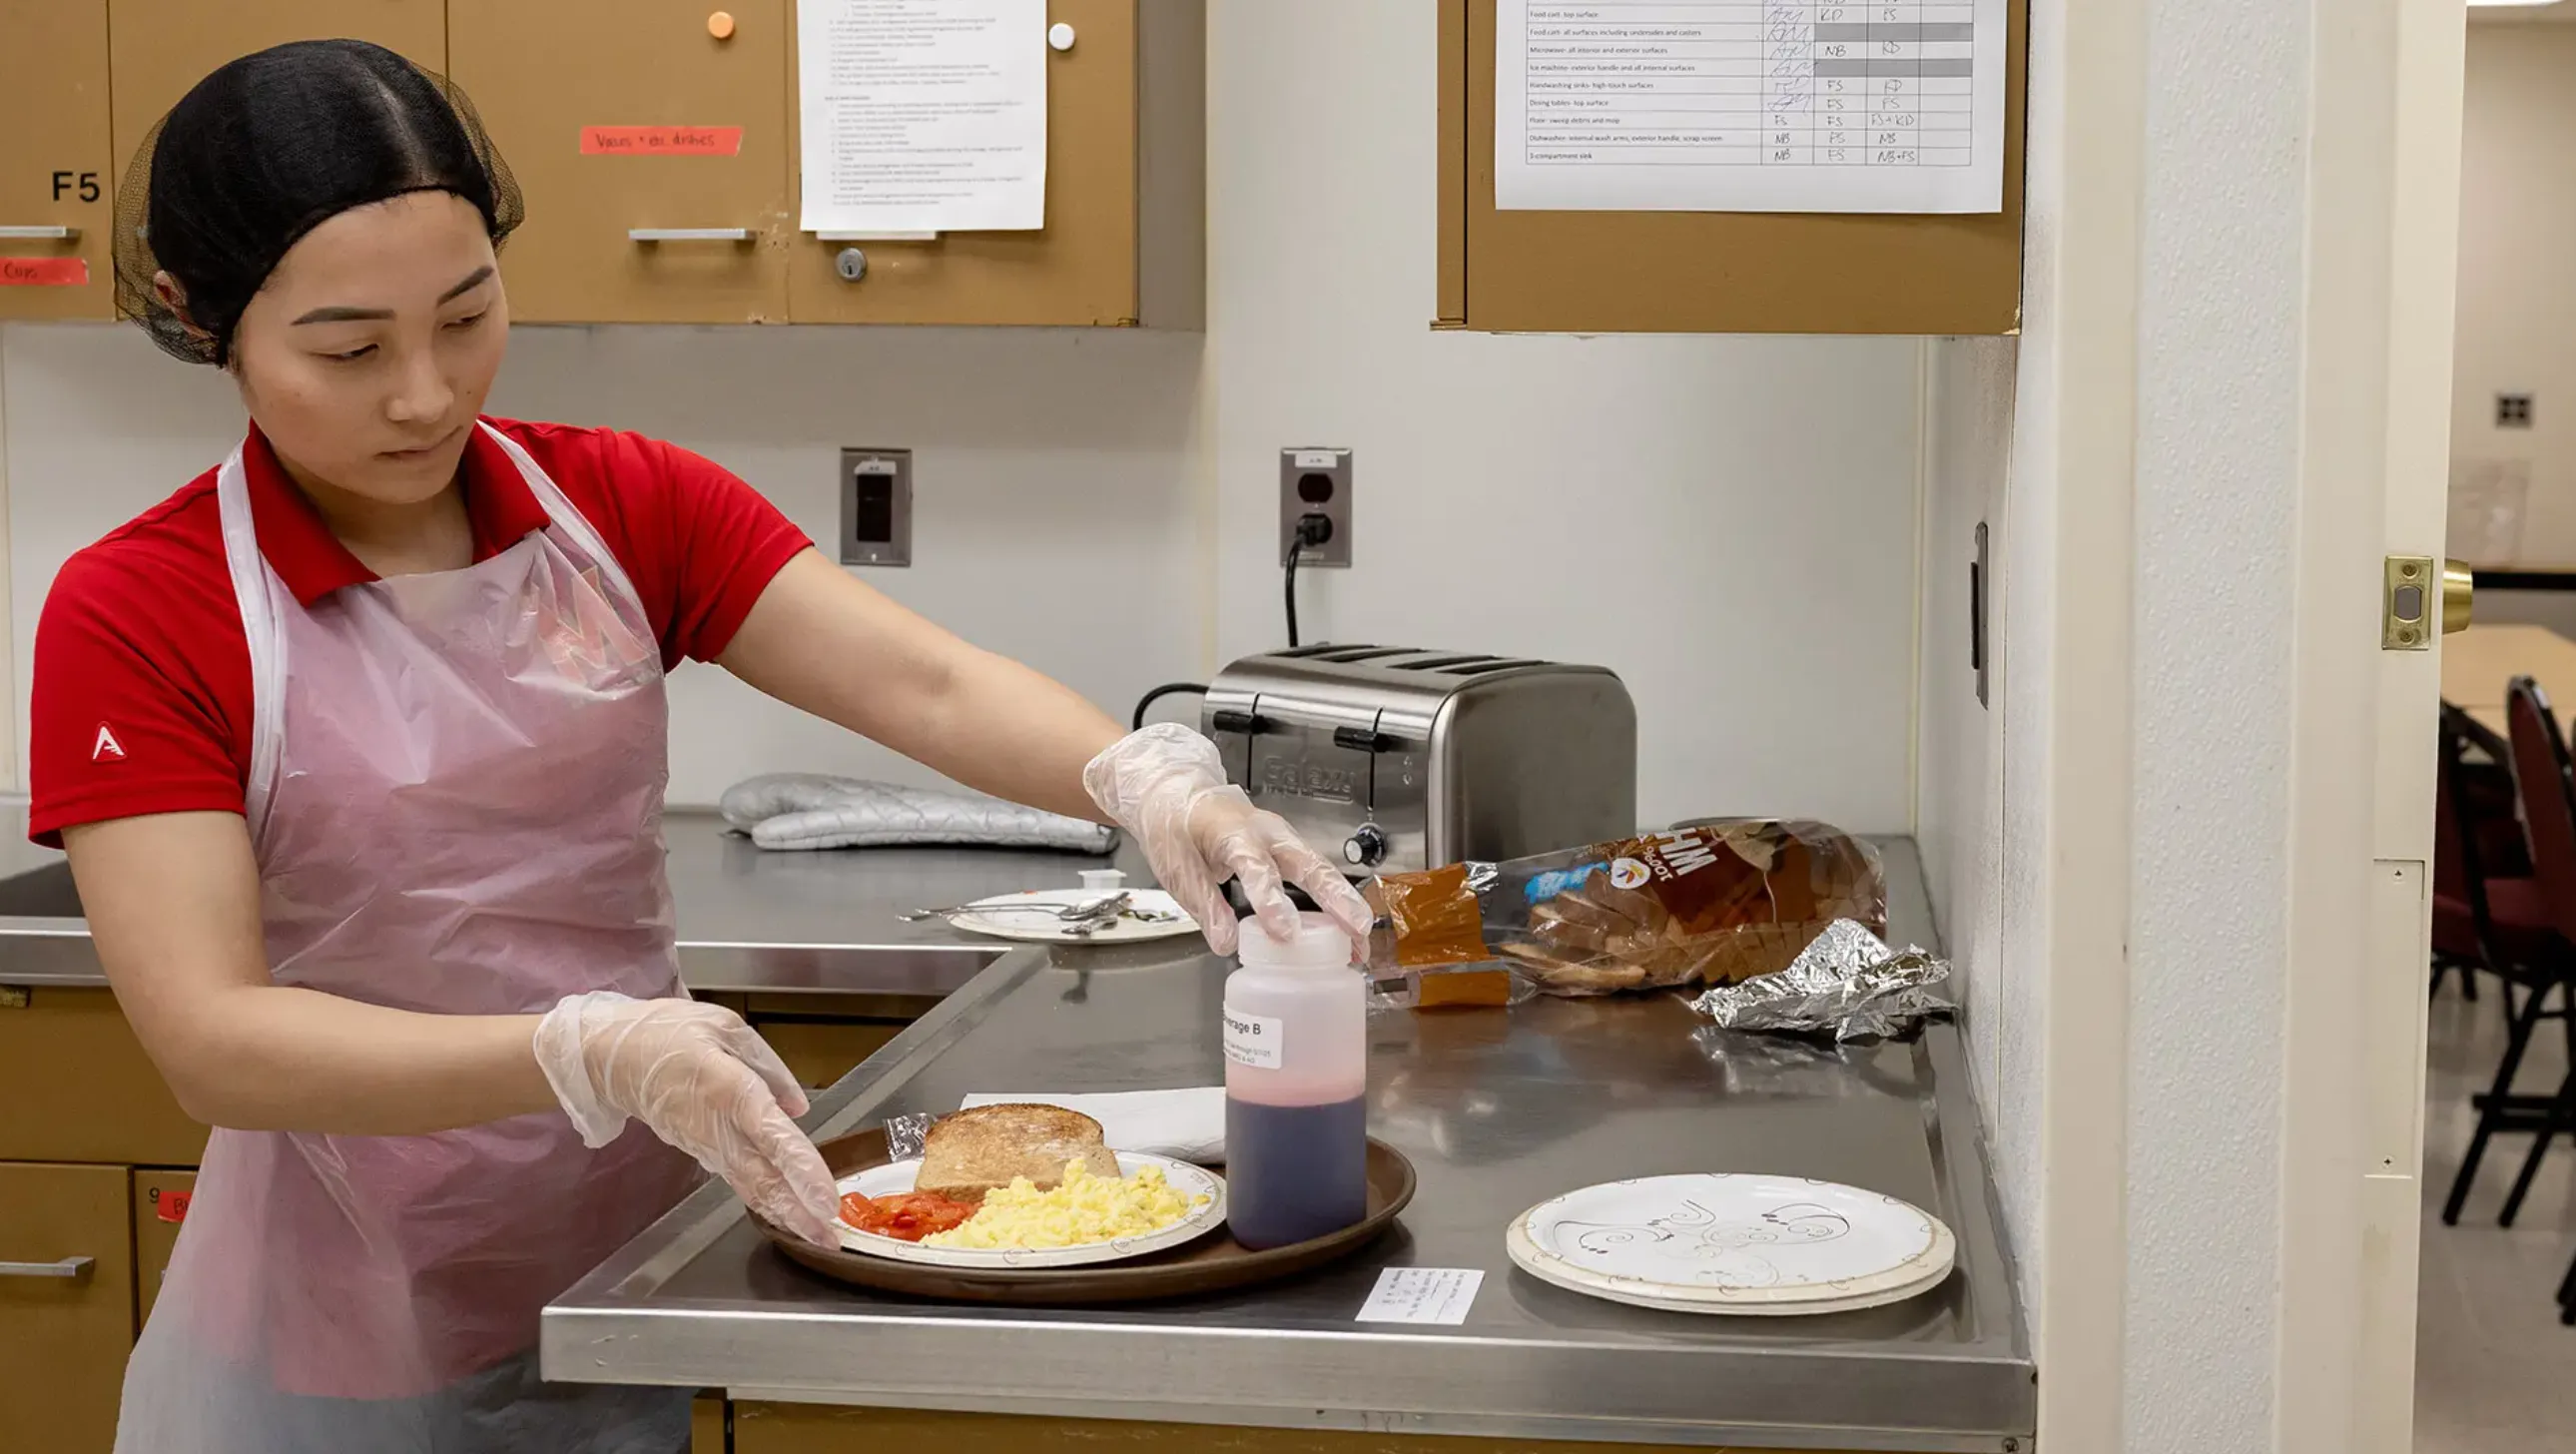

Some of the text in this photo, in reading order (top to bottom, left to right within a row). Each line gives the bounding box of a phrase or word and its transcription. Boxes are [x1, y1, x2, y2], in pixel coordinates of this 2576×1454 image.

[1825, 46, 1846, 57] NB
[1827, 80, 1843, 92] FS
[1827, 99, 1843, 110] FS
[1827, 115, 1843, 127] FS
[1641, 845, 1674, 883] 100%
[1252, 1023, 1262, 1036] B
[149, 1186, 161, 1204] 9
